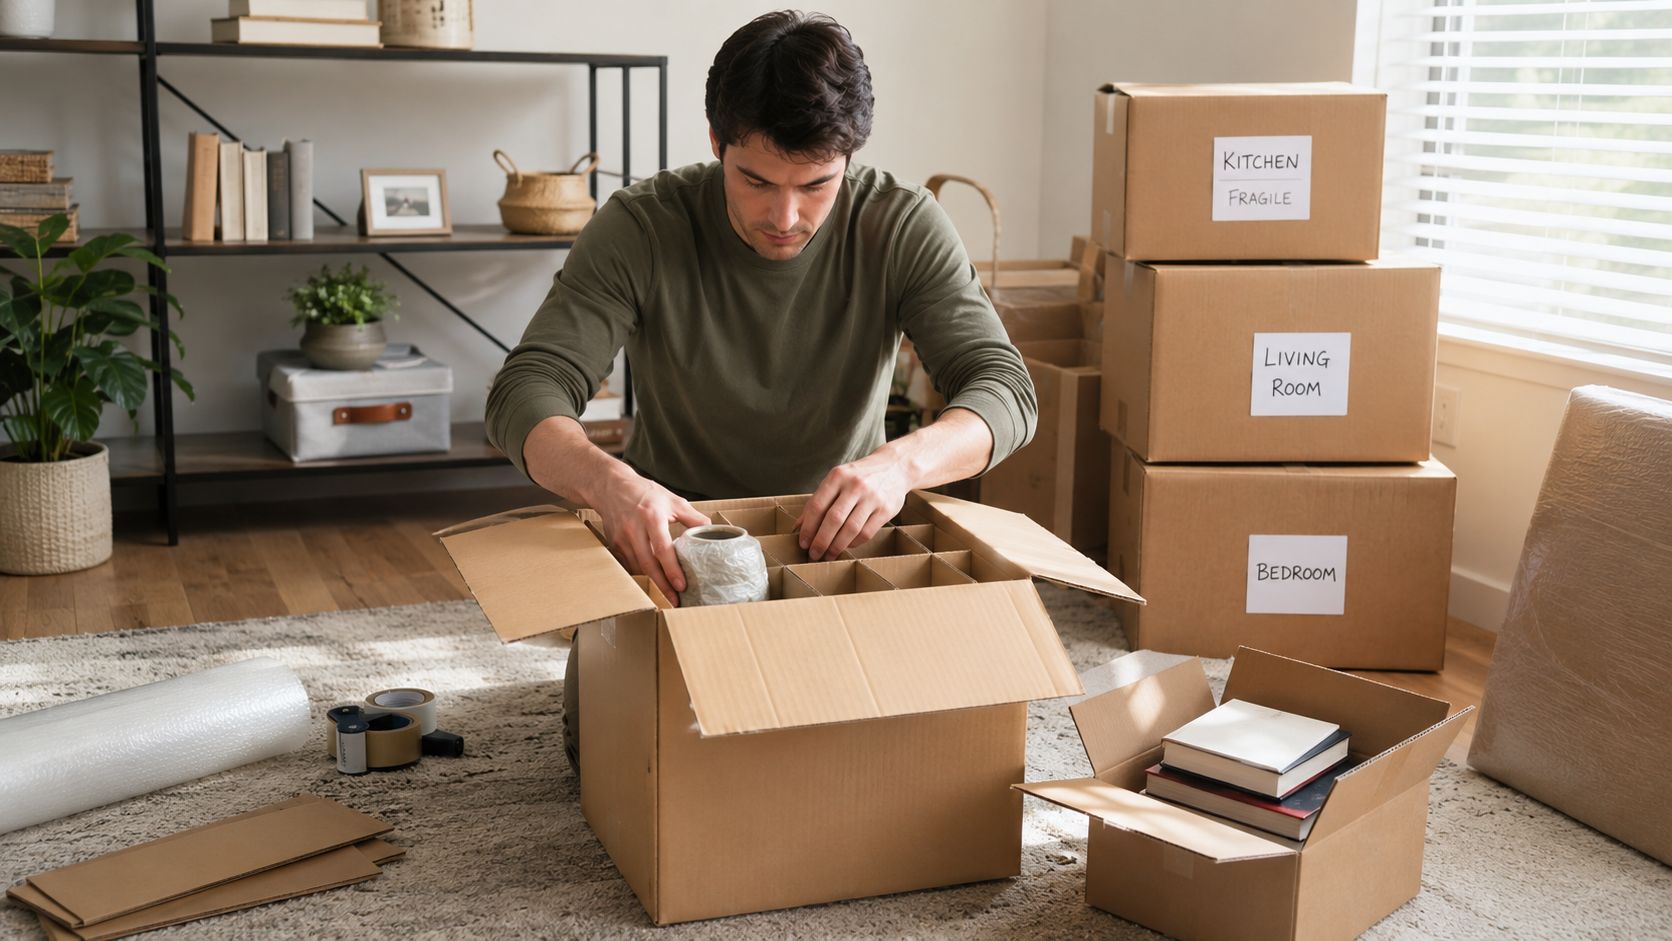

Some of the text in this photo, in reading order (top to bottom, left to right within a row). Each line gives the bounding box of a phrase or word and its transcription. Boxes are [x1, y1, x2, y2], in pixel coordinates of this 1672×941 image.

[1223, 151, 1299, 170] KITCHEN
[1228, 188, 1292, 206] FRAGILE
[1264, 347, 1330, 368] LIVING
[1272, 377, 1322, 398] ROOM
[1256, 562, 1337, 583] BEDROOM
